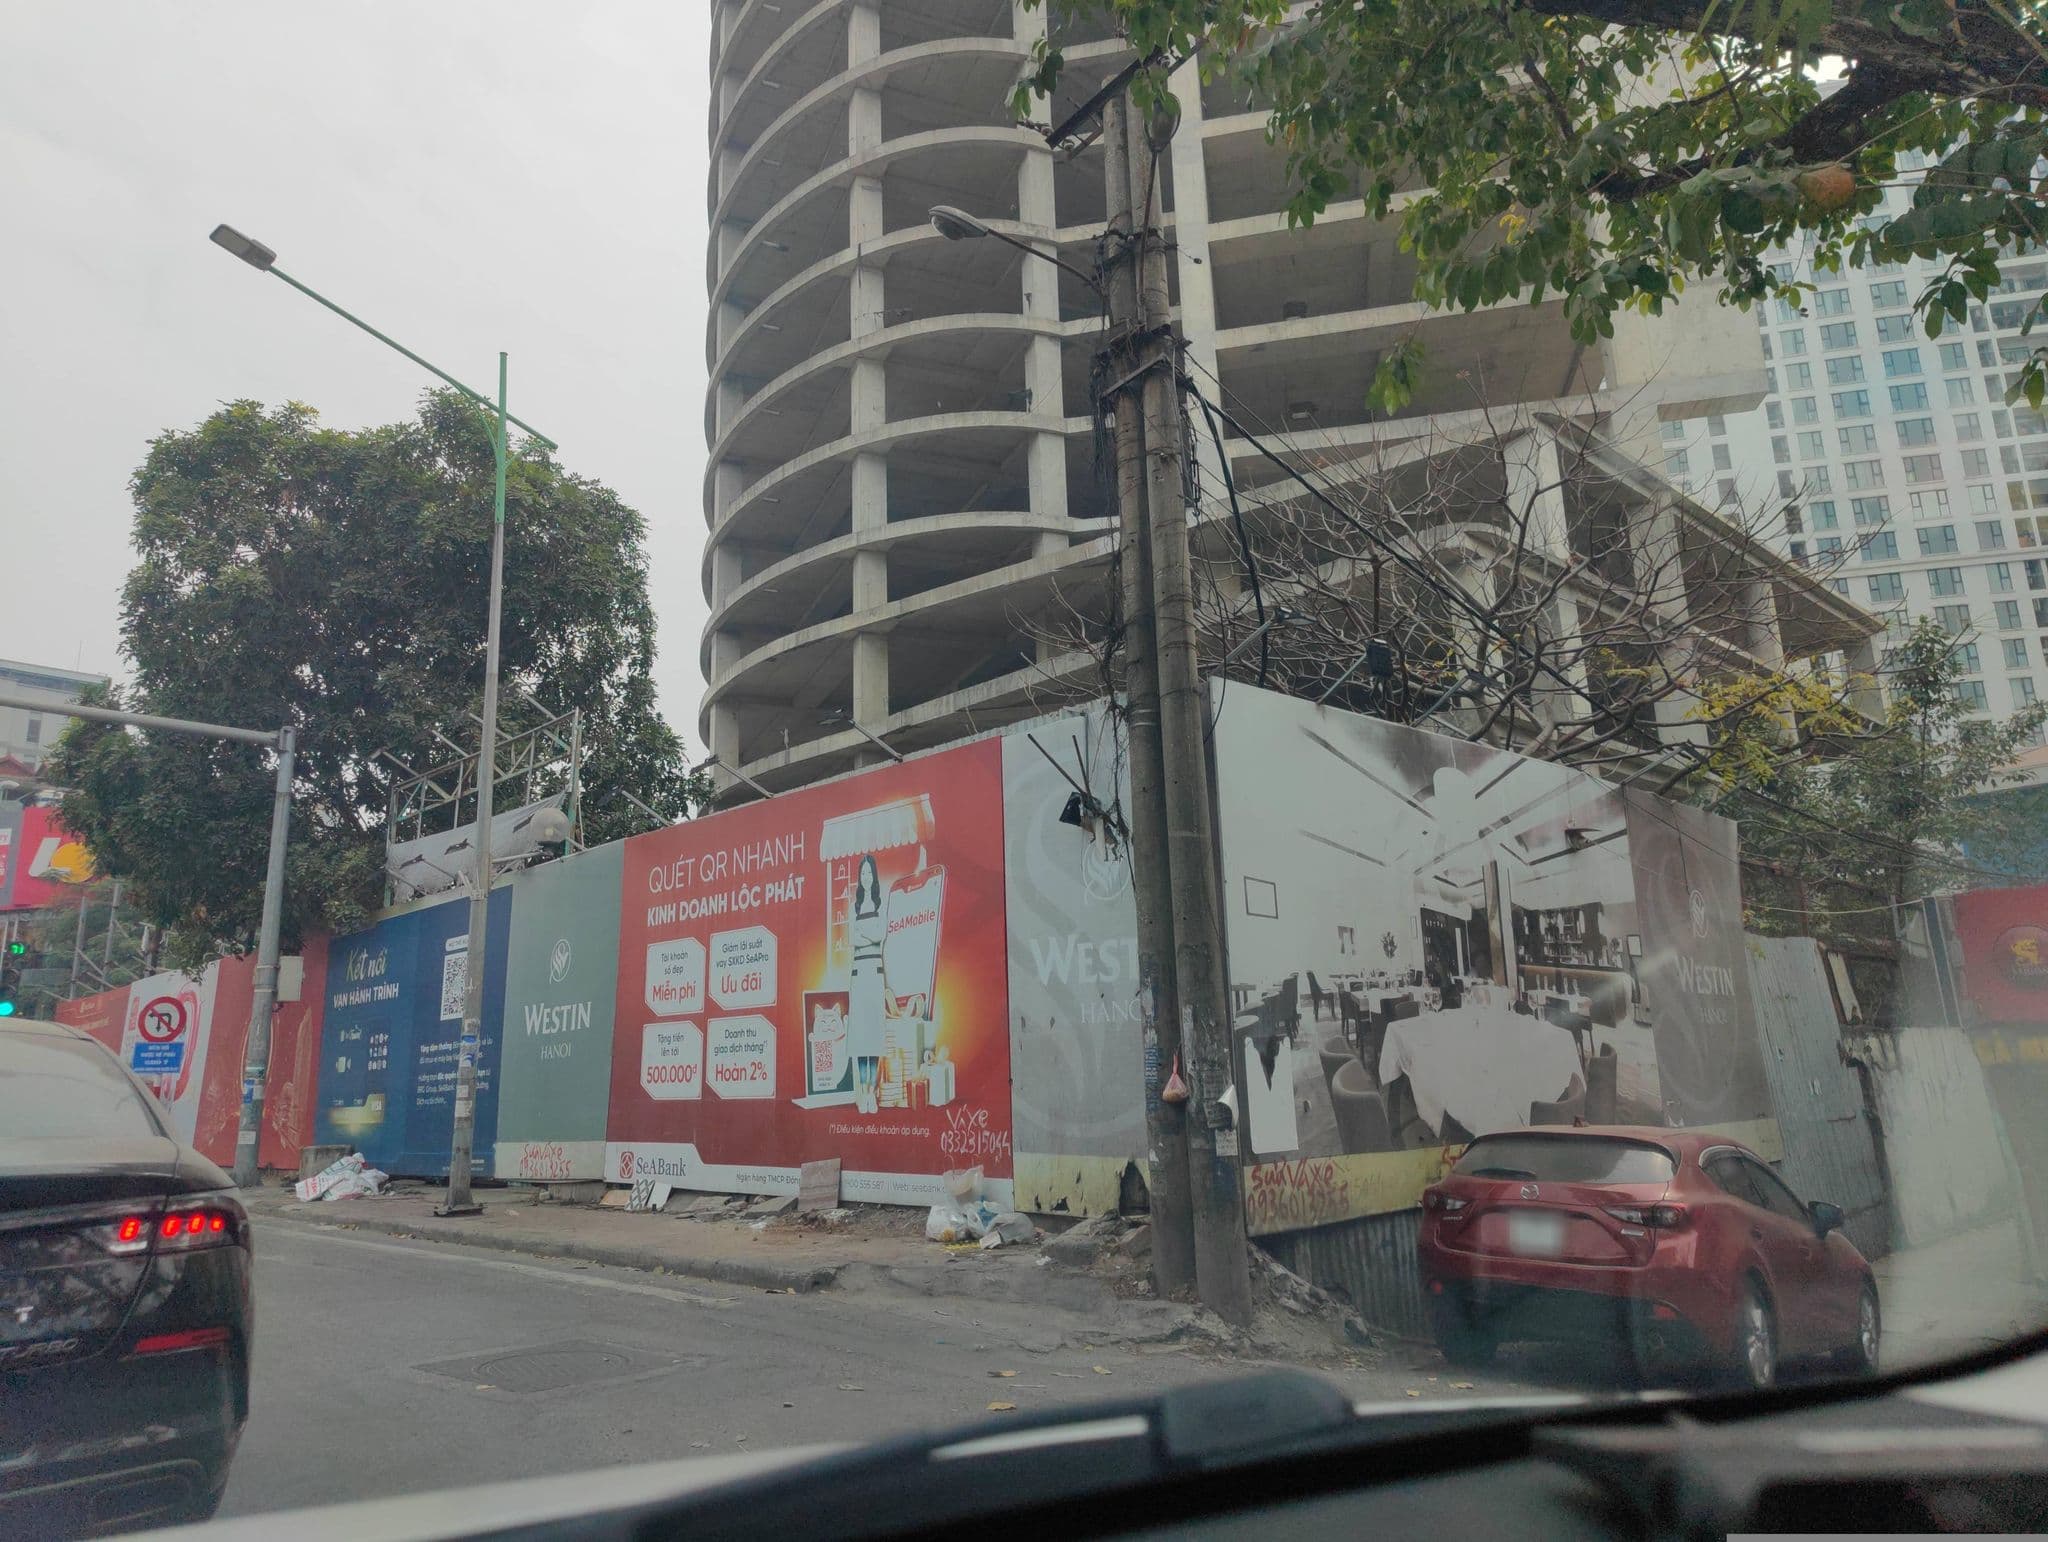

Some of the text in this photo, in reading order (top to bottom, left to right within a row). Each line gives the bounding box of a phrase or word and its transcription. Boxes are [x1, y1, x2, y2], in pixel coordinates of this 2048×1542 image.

[649, 832, 805, 893] QUÉT QR NHANH
[647, 873, 805, 927] KINH DOANH LỘC PHÁT
[888, 910, 936, 934] SeAMobile
[1029, 934, 1138, 986] WEST
[652, 980, 697, 1004] Miễn phí
[721, 972, 762, 993] Ưu đãi
[524, 1001, 592, 1036] WESTIN
[1081, 999, 1142, 1024] HANO
[725, 1028, 757, 1039] Doanh thu
[540, 1042, 571, 1061] HANOI
[715, 1061, 768, 1082] Hoàn 2%
[635, 1156, 686, 1177] SeABank
